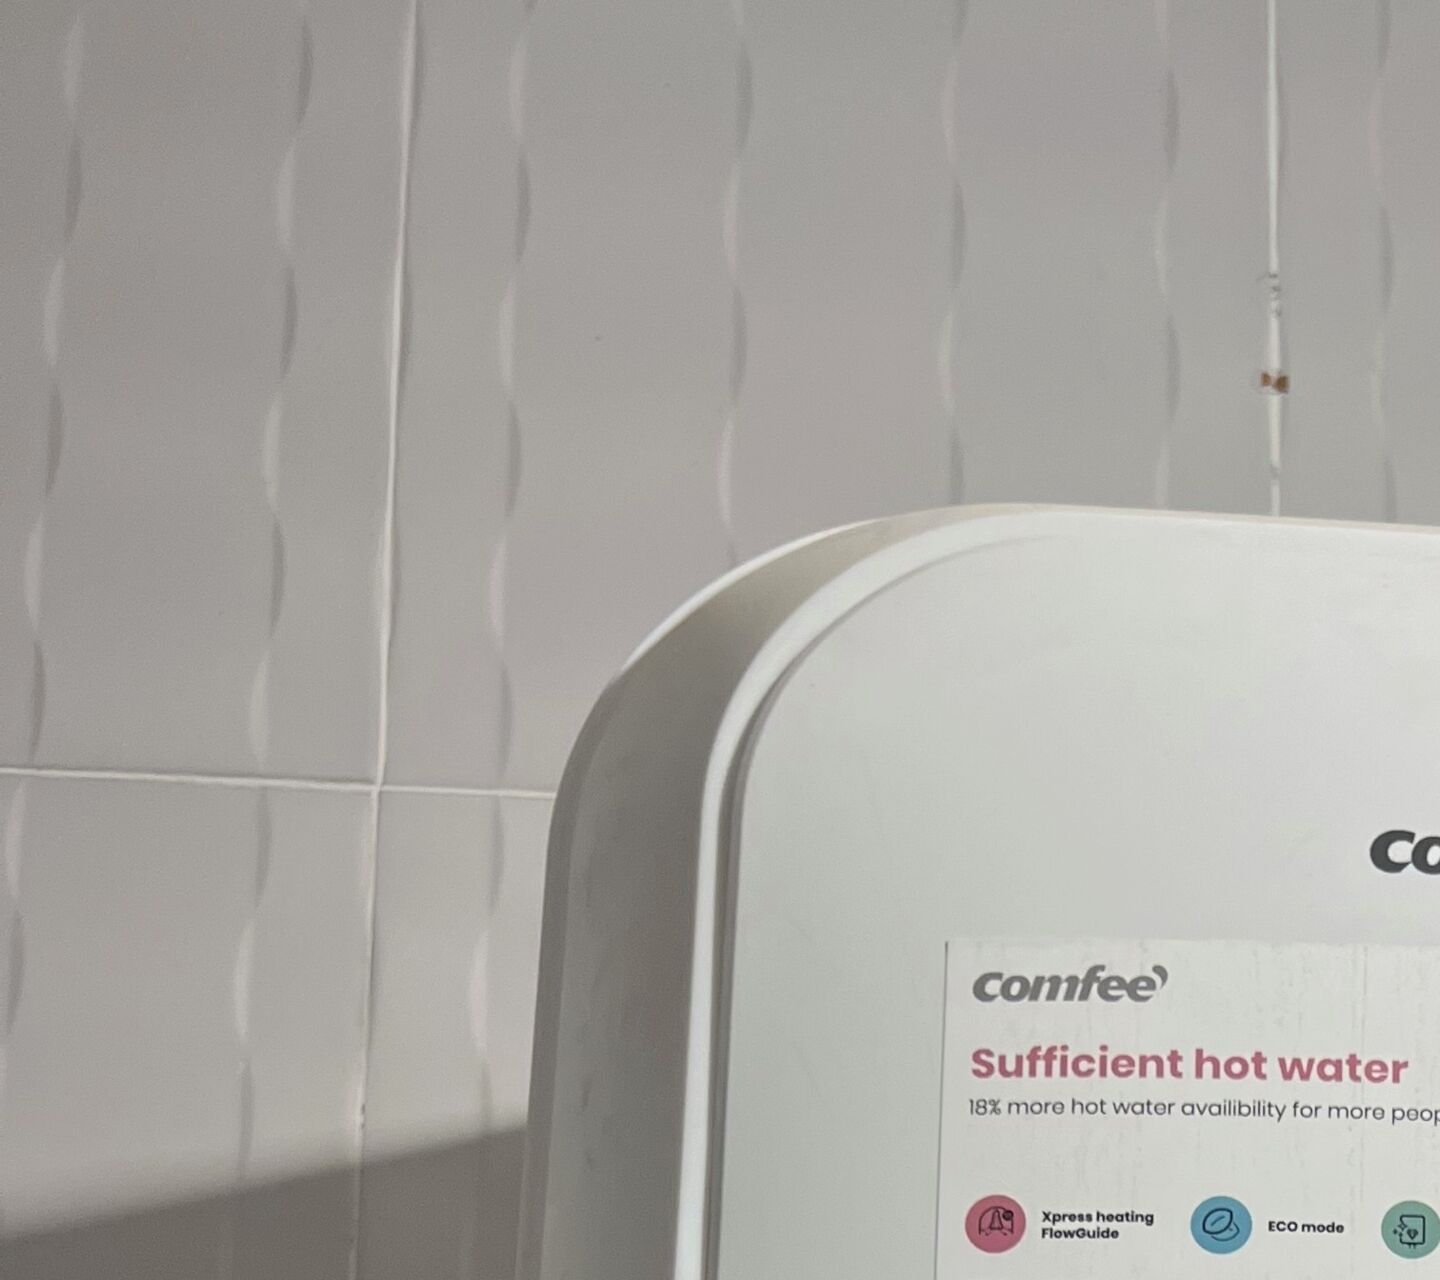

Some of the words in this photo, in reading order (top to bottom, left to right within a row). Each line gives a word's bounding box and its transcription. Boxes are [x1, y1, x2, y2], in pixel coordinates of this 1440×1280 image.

[971, 1044, 1184, 1079] Sufficient
[1194, 1047, 1268, 1081] hot
[1277, 1053, 1409, 1084] water
[967, 1097, 1002, 1117] 18%
[1007, 1101, 1065, 1115] more
[1071, 1097, 1107, 1115] hot
[1112, 1099, 1176, 1116] water
[1180, 1099, 1287, 1123] availibility
[1292, 1101, 1322, 1119] for
[1327, 1105, 1386, 1121] more
[1042, 1210, 1093, 1226] Xpress
[1095, 1210, 1155, 1229] heating
[1268, 1220, 1299, 1233] ECO
[1301, 1221, 1345, 1234] mode
[1040, 1223, 1120, 1240] FlowGuide
